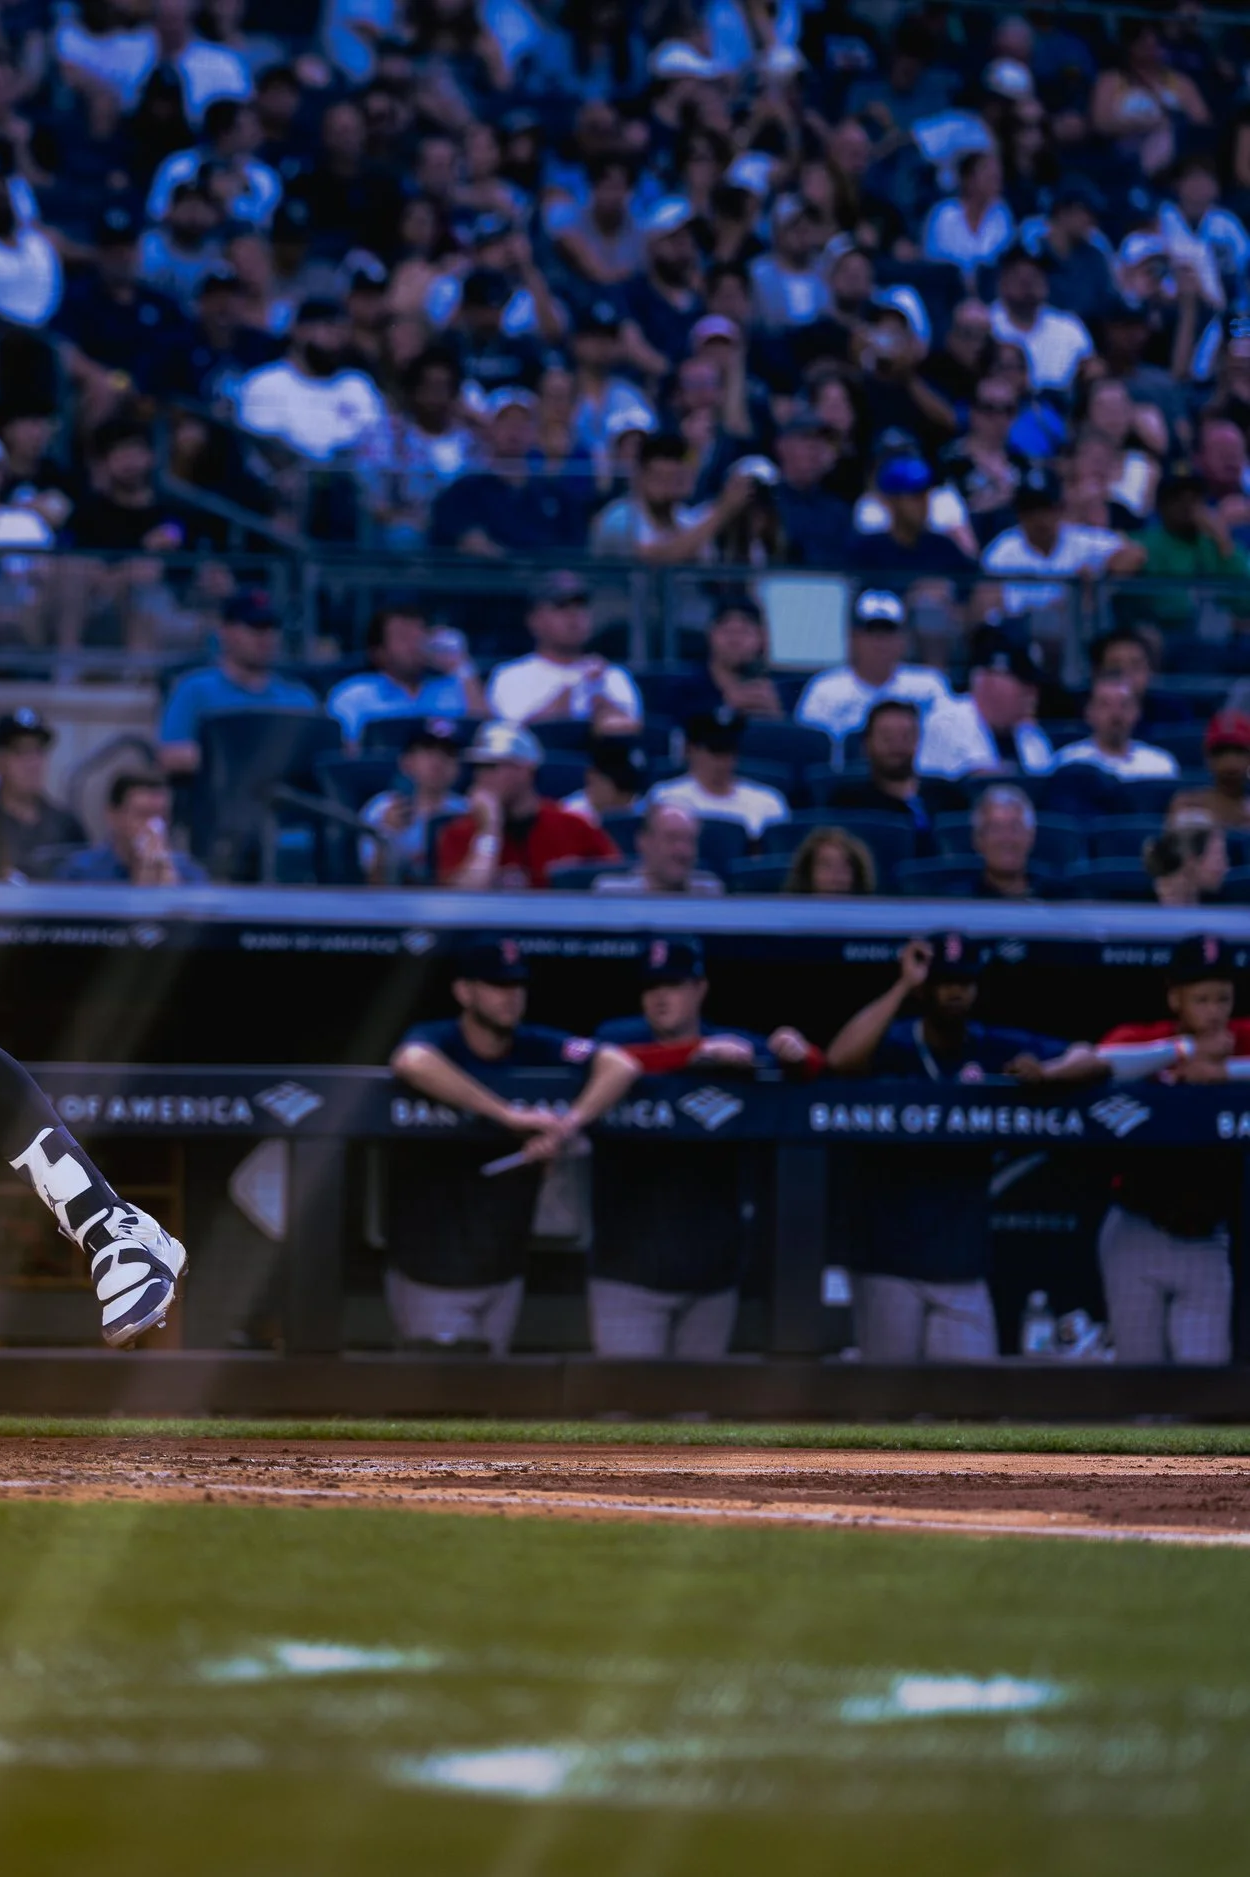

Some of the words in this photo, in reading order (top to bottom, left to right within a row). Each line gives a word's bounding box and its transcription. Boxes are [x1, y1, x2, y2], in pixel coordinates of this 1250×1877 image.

[57, 1094, 102, 1123] OF
[105, 1095, 254, 1125] AMERICA
[390, 1098, 472, 1127] BAN
[810, 1102, 896, 1132] BANK
[900, 1104, 942, 1133] OF
[946, 1105, 1084, 1136] AMERICA
